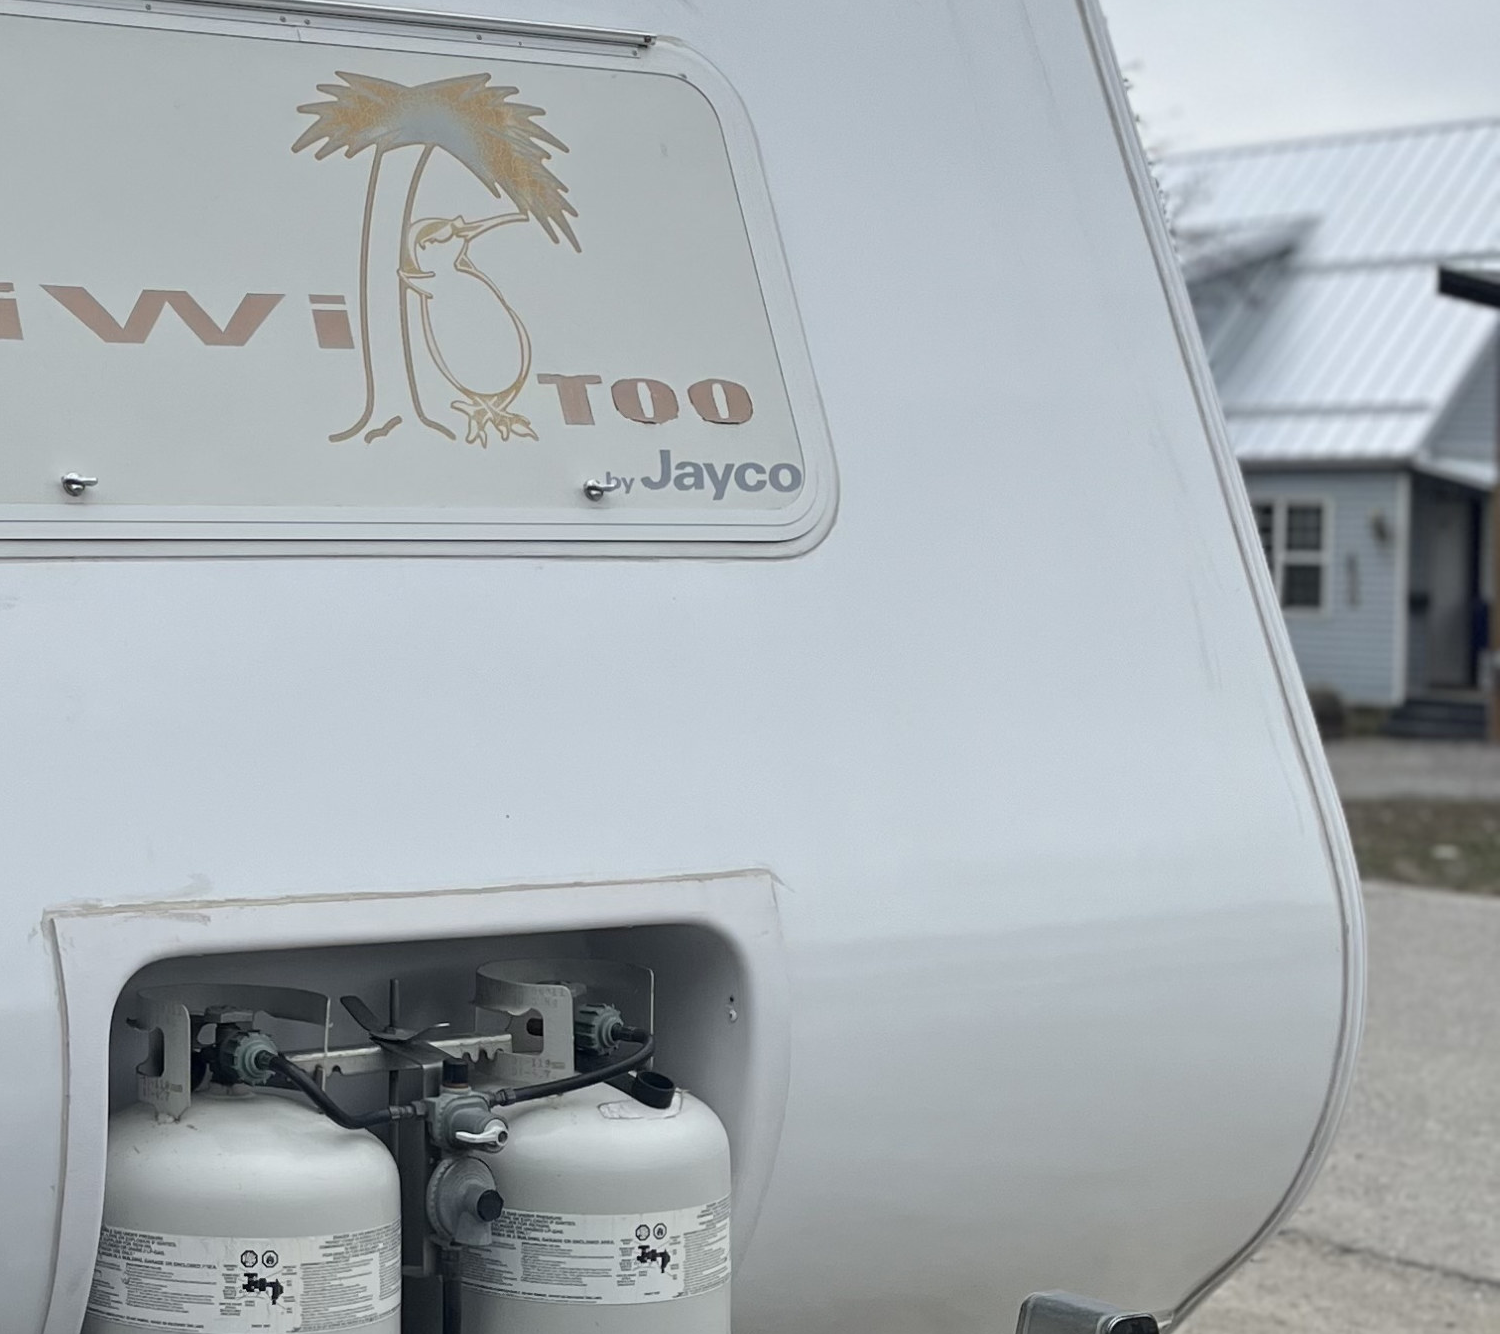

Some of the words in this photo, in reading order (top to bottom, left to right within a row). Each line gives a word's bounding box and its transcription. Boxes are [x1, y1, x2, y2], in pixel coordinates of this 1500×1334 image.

[537, 373, 753, 425] TOO
[605, 471, 635, 494] by
[641, 450, 802, 501] Jayco
